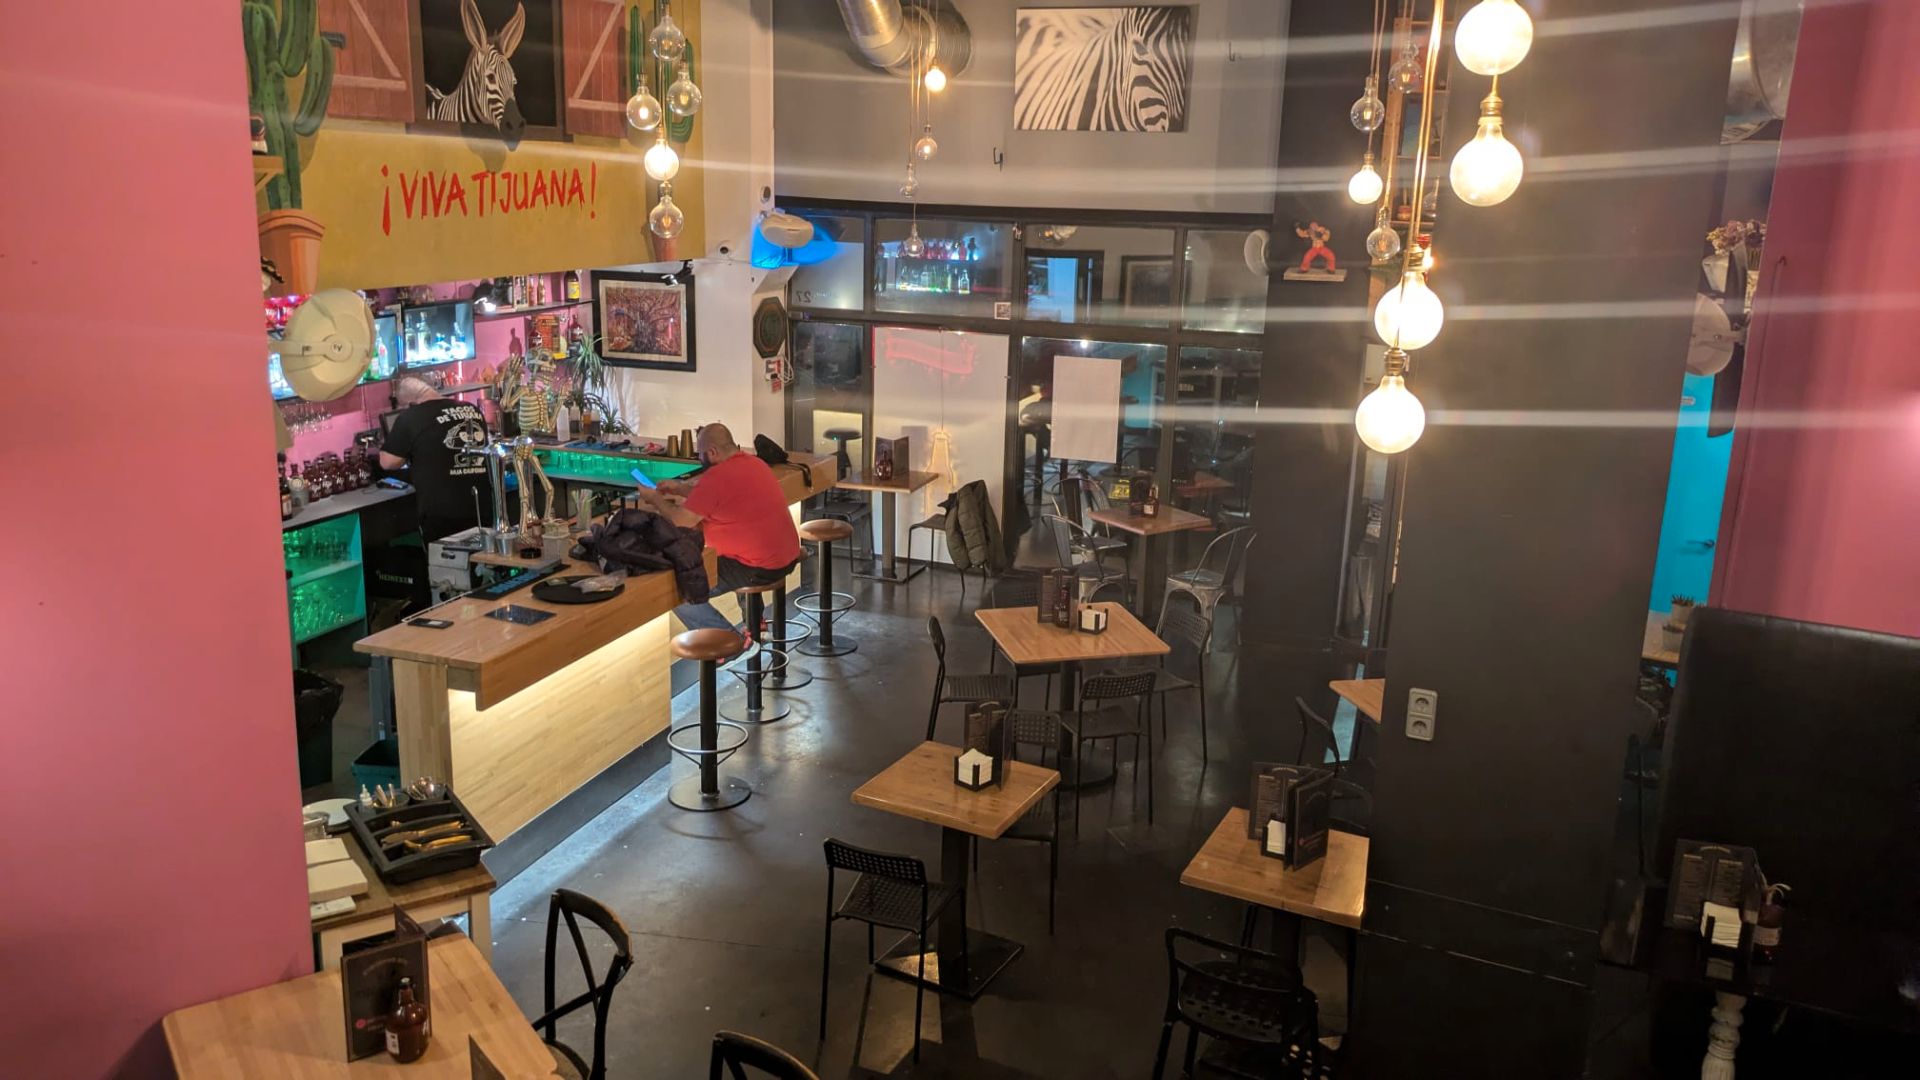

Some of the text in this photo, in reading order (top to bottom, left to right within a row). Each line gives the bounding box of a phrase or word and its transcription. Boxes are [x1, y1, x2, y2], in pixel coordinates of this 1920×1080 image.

[381, 161, 596, 236] ¡VIVA TIJUANA!
[442, 405, 475, 415] TACOS
[436, 415, 451, 424] DE
